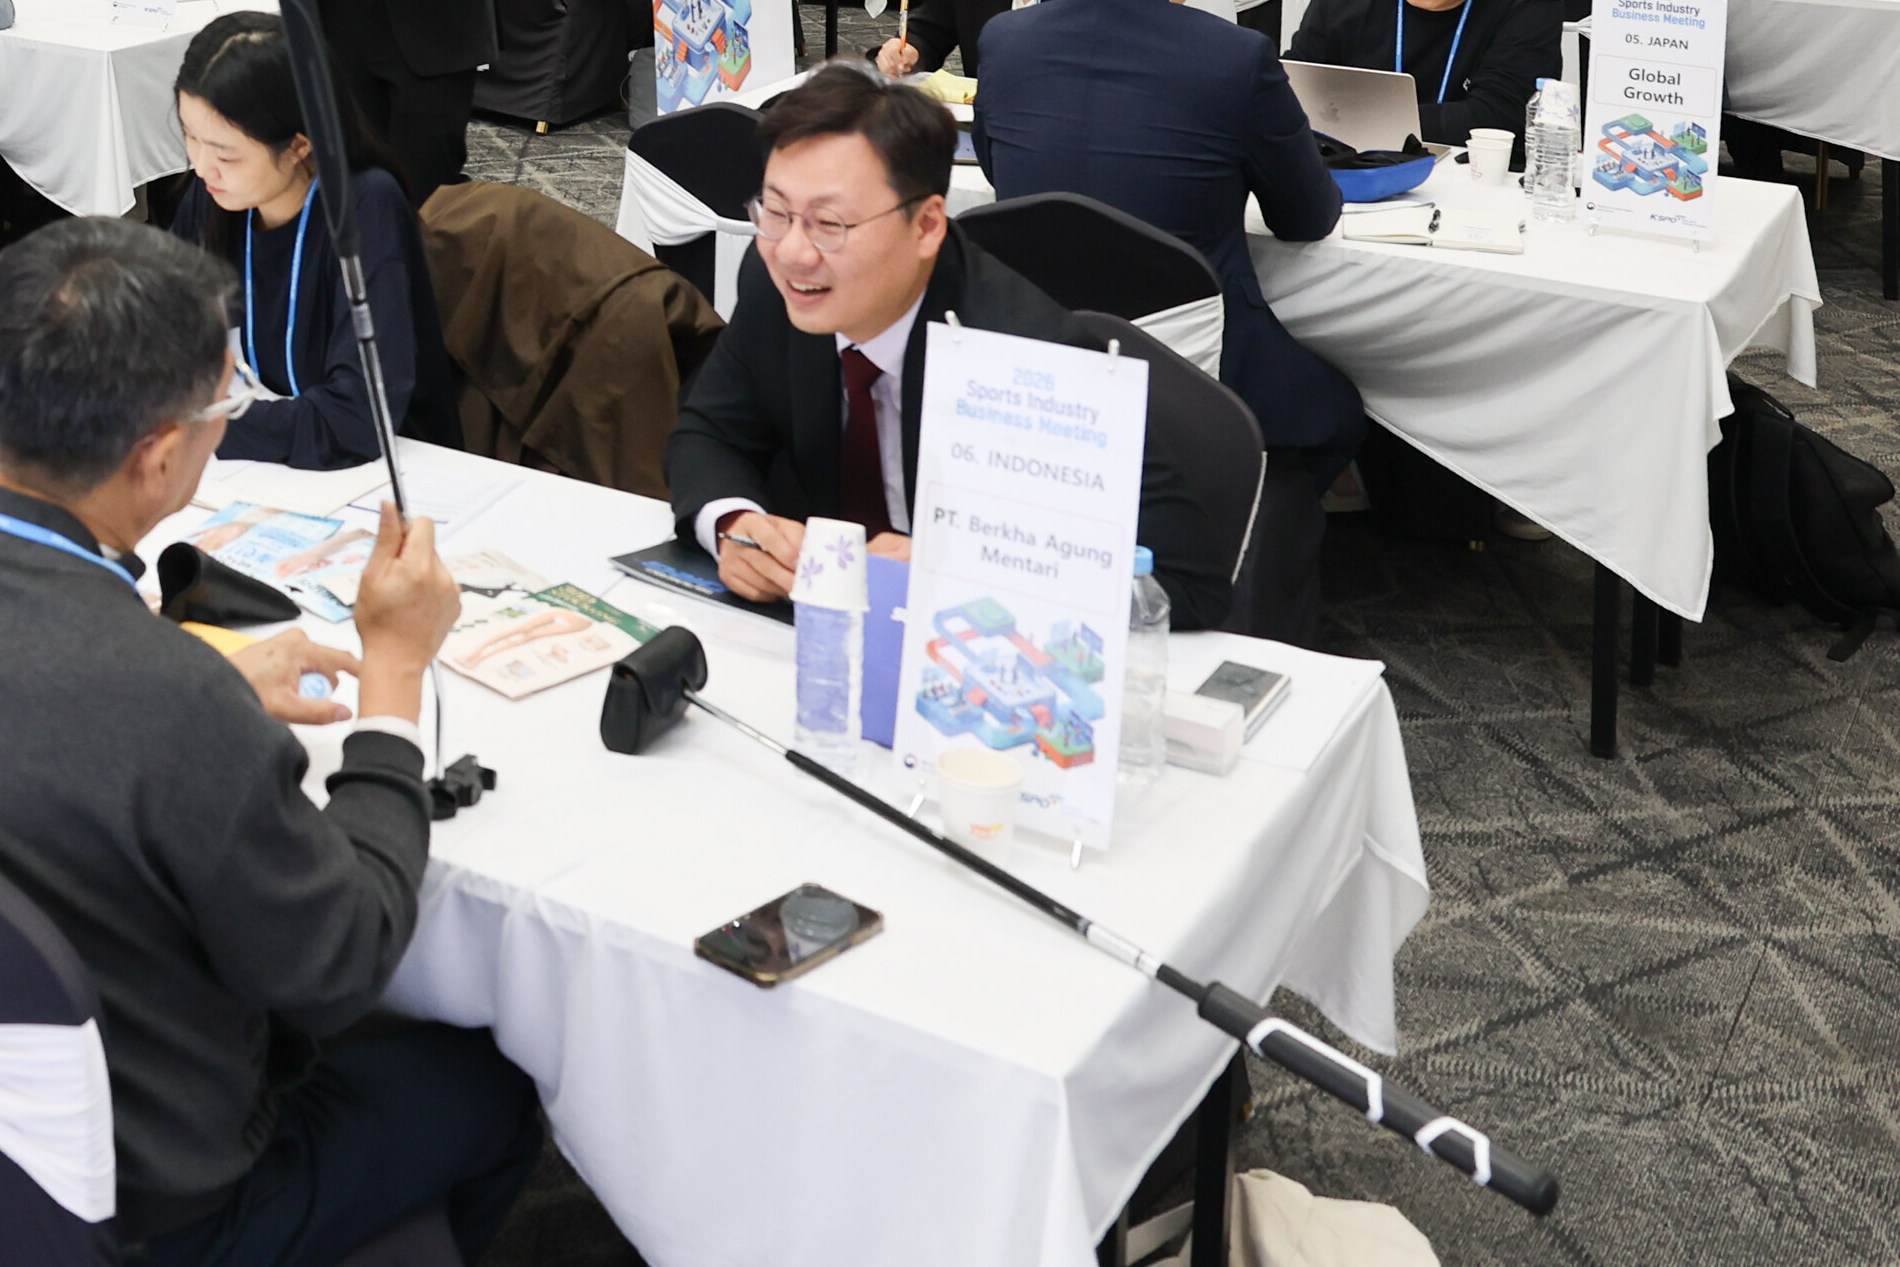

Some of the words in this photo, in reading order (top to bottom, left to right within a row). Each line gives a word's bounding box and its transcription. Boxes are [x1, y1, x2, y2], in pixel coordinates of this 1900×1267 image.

[1612, 8, 1660, 23] Business
[1663, 14, 1706, 30] Meeting
[1656, 1, 1700, 16] Industry
[1624, 34, 1644, 46] 05.
[1647, 36, 1689, 50] JAPAN
[1628, 68, 1681, 86] Global
[1624, 86, 1684, 106] Growth
[1012, 366, 1055, 393] 2026
[965, 377, 1024, 410] Sports
[1027, 389, 1101, 427] Industry
[955, 397, 1032, 431] Business
[1037, 412, 1109, 450] Meeting
[950, 442, 980, 466] 06.
[987, 449, 1107, 494] INDONESIA
[932, 505, 962, 530] PT.
[968, 513, 1038, 549] Berkha
[1044, 531, 1114, 570] Agung
[979, 545, 1061, 581] Mentari
